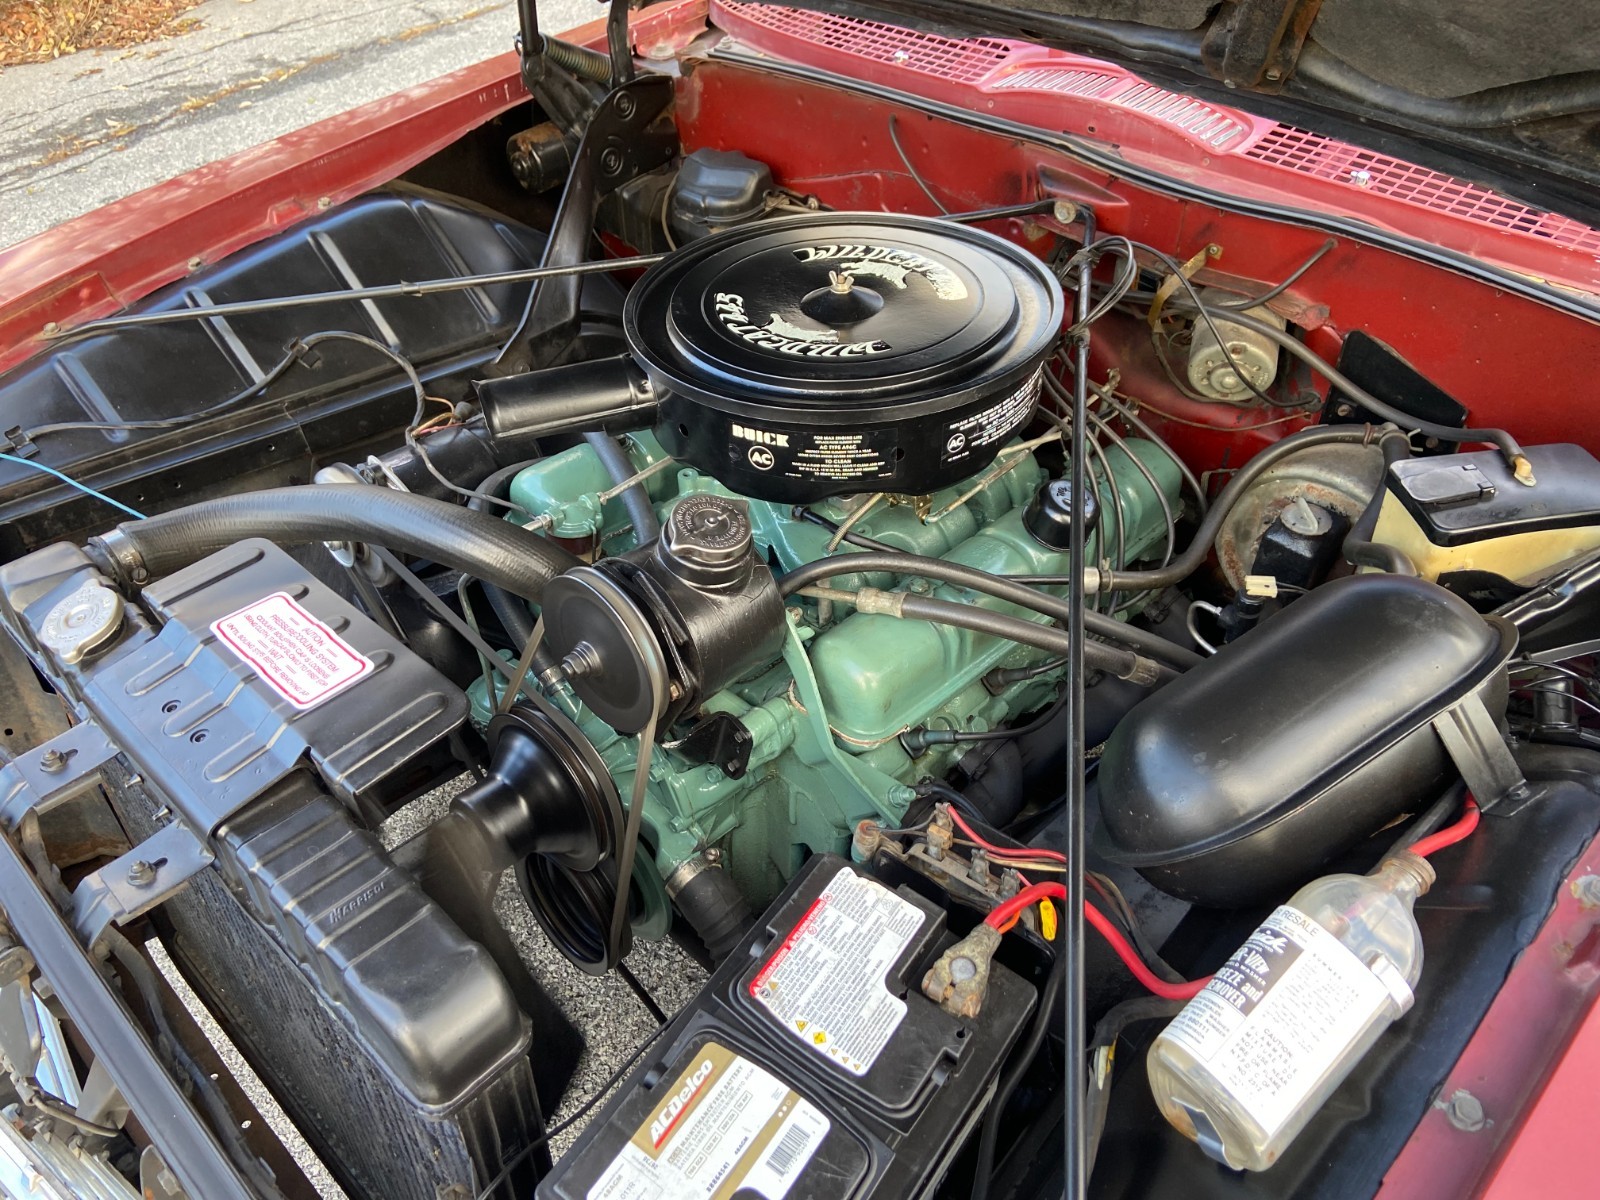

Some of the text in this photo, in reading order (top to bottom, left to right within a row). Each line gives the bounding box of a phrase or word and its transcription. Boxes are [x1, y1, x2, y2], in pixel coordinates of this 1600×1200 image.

[732, 424, 789, 447] BUICK
[949, 436, 963, 449] AC
[751, 450, 772, 466] AC
[302, 628, 323, 646] AUTION
[1281, 910, 1319, 937] RESALE
[1240, 963, 1266, 986] WASHER
[1208, 978, 1245, 1007] EMOVER
[1241, 983, 1263, 1001] and
[1202, 1002, 1220, 1016] DEALER
[1205, 1019, 1225, 1036] NUMBER
[1209, 1013, 1229, 1031] WASHER
[1263, 1028, 1292, 1057] CAUTION
[1235, 1043, 1247, 1056] FIRE
[1251, 1058, 1260, 1067] OR
[1262, 1069, 1280, 1089] FLAME
[1241, 1037, 1287, 1085] NOT USE NEAR
[1245, 1031, 1292, 1079] MIXTURE DO
[650, 1058, 713, 1143] ACDelco
[680, 1104, 712, 1146] MAINTENANCE
[723, 1065, 742, 1089] BATTERY
